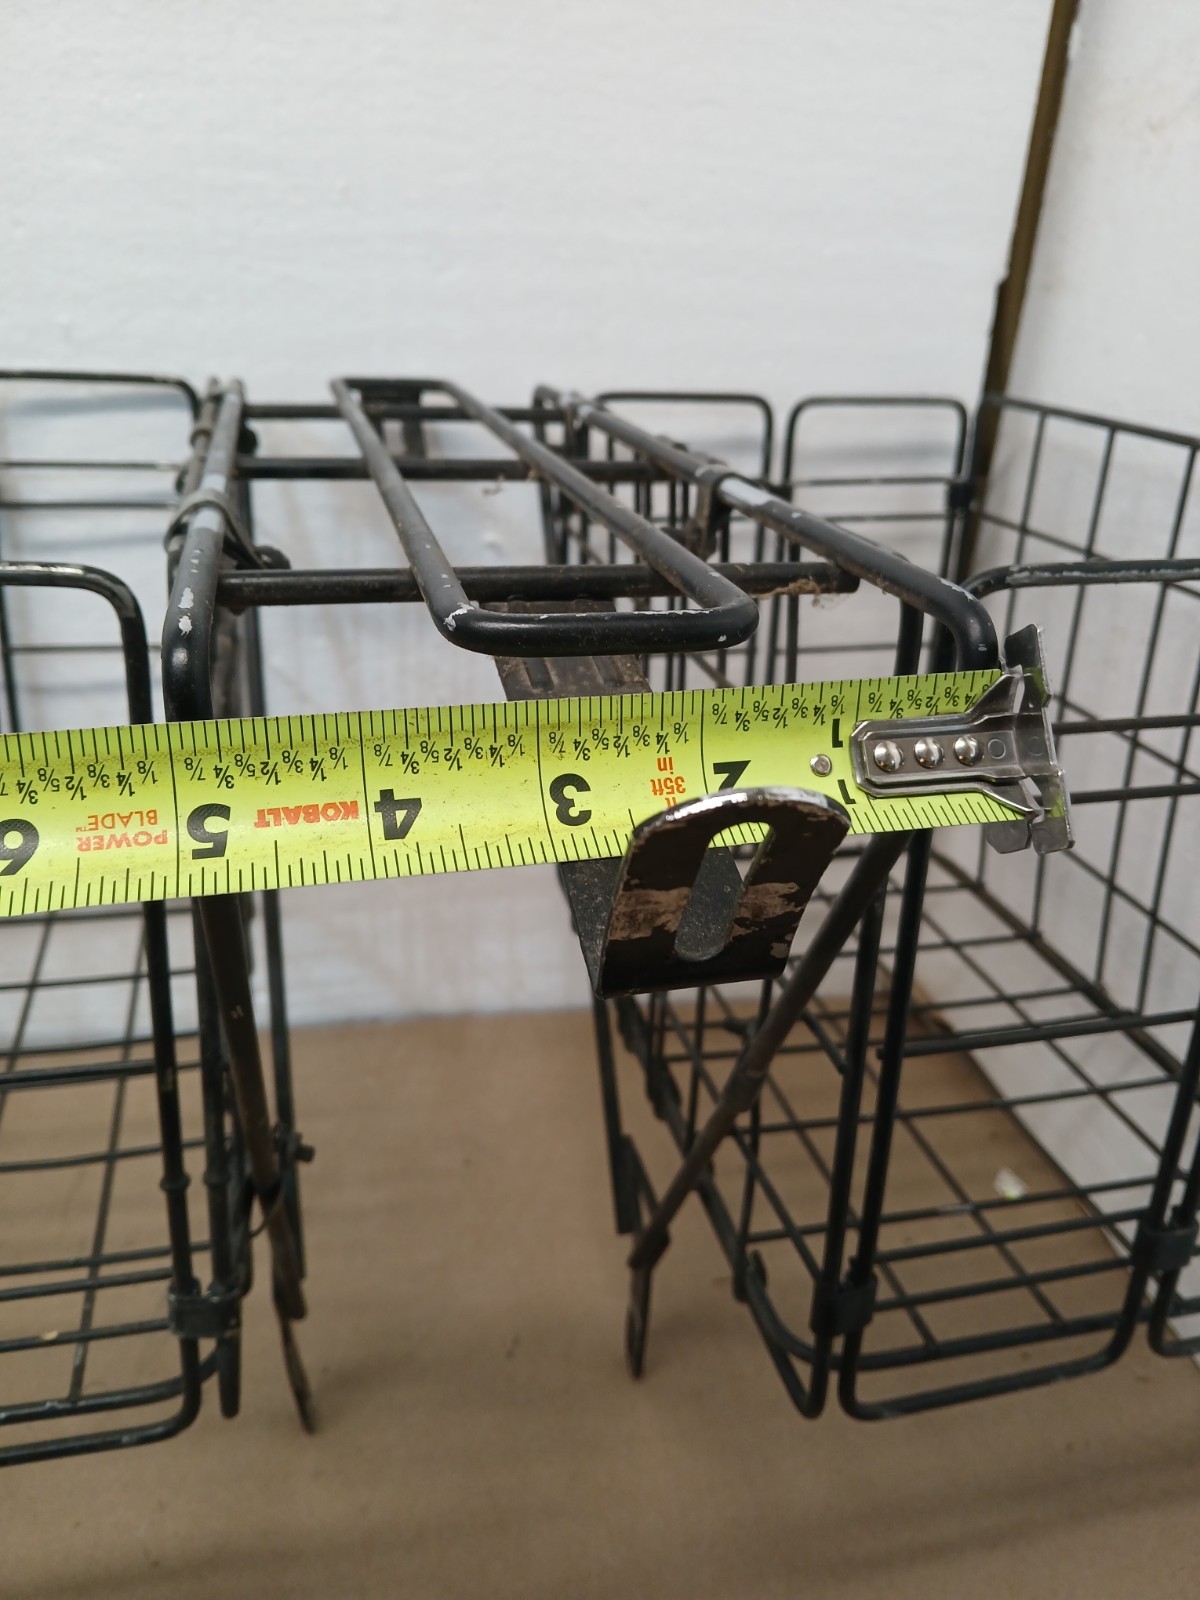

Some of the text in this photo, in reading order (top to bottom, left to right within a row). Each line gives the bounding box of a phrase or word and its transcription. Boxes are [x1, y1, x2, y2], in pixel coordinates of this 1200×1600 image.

[830, 694, 846, 716] 1/8
[868, 692, 883, 713] 7/8
[907, 689, 922, 710] 5/8
[944, 686, 961, 707] 3/8
[711, 703, 728, 725] 7/8
[752, 700, 770, 722] 5/8
[772, 708, 789, 730] 1/2
[791, 698, 809, 719] 3/8
[812, 704, 827, 726] 1/4
[734, 710, 751, 732] 3/4
[548, 731, 566, 753] 7/8
[591, 728, 610, 750] 5/8
[632, 725, 650, 747] 3/8
[655, 732, 671, 755] 1/4
[673, 722, 690, 744] 1/8
[831, 718, 844, 749] 1
[373, 744, 393, 766] 7/8
[419, 740, 440, 763] 5/8
[463, 737, 484, 760] 3/8
[489, 745, 505, 767] 1/4
[507, 734, 525, 756] 1/8
[572, 738, 591, 761] 3/4
[612, 736, 631, 758] 1/2
[184, 757, 206, 781] 7/8
[233, 753, 256, 777] 5/8
[281, 750, 304, 773] 3/8
[309, 758, 327, 781] 1/4
[329, 747, 348, 770] 1/8
[400, 751, 420, 774] 3/4
[443, 748, 463, 771] 1/2
[656, 757, 674, 775] in
[37, 767, 60, 792] 5/8
[86, 763, 110, 788] 3/8
[136, 760, 159, 784] 1/8
[213, 765, 235, 789] 3/4
[259, 761, 281, 785] 1/2
[16, 779, 39, 805] 3/4
[64, 776, 87, 801] 1/2
[116, 771, 135, 797] 1/4
[650, 776, 687, 796] 35ft
[837, 779, 857, 805] 1
[549, 773, 592, 827] 3
[253, 801, 359, 828] KOBALT
[373, 789, 423, 841] 4
[75, 829, 168, 852] POWER
[186, 803, 231, 860] 5
[0, 818, 40, 877] 6
